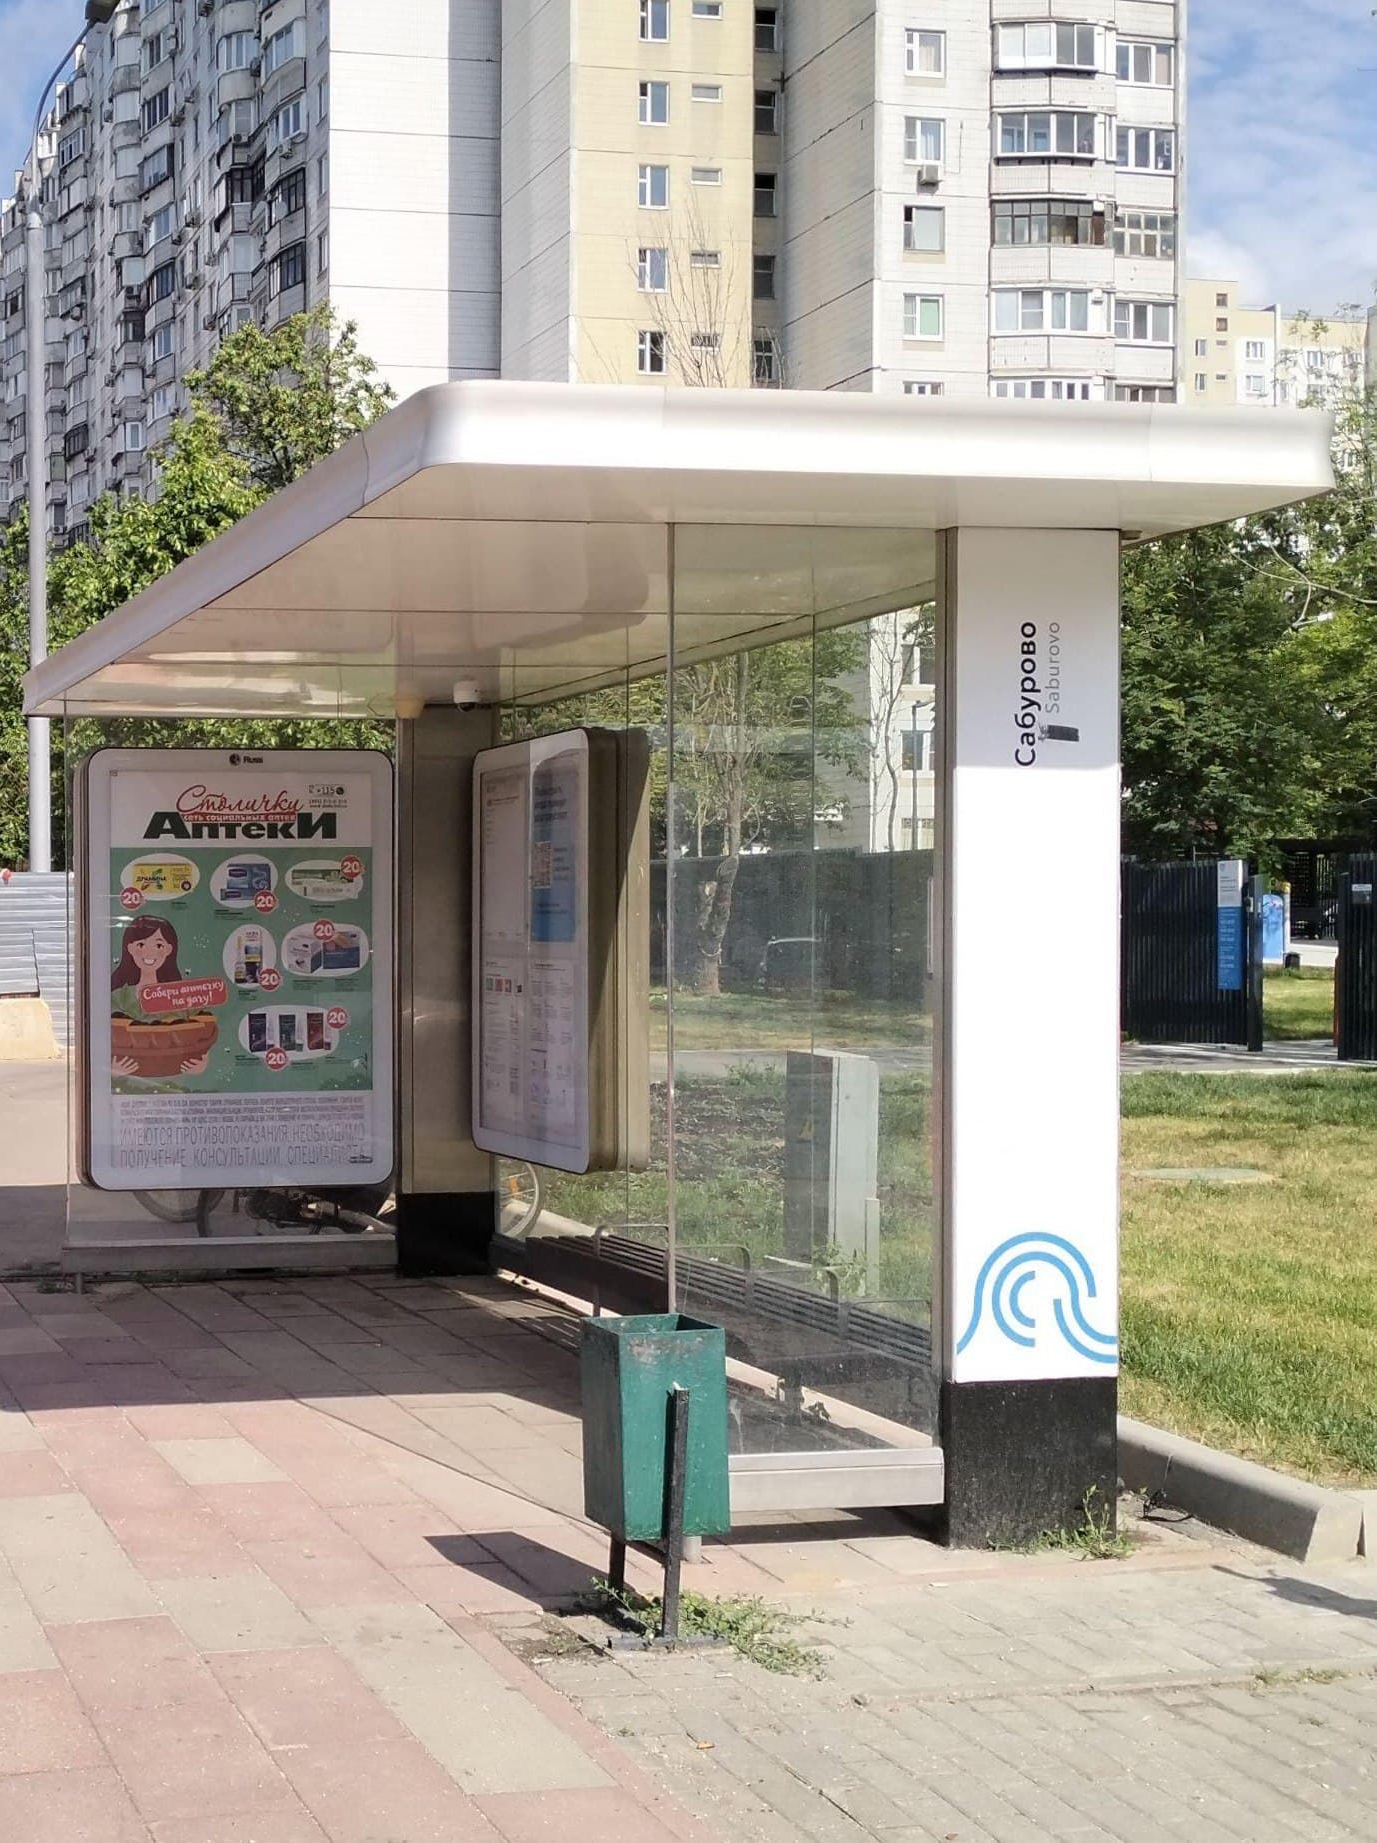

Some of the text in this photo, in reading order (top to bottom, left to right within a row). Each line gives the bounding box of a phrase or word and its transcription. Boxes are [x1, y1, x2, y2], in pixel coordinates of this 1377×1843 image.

[1045, 621, 1061, 714] Saburovo
[1014, 621, 1042, 767] Сабурово
[176, 784, 305, 812] Столички
[343, 861, 361, 873] 20
[123, 892, 140, 904] 20
[256, 895, 274, 908] 20
[315, 924, 333, 937] 20
[260, 973, 278, 986] 20
[143, 987, 179, 1000] Собери
[328, 1011, 346, 1024] 20
[267, 1052, 285, 1065] 20
